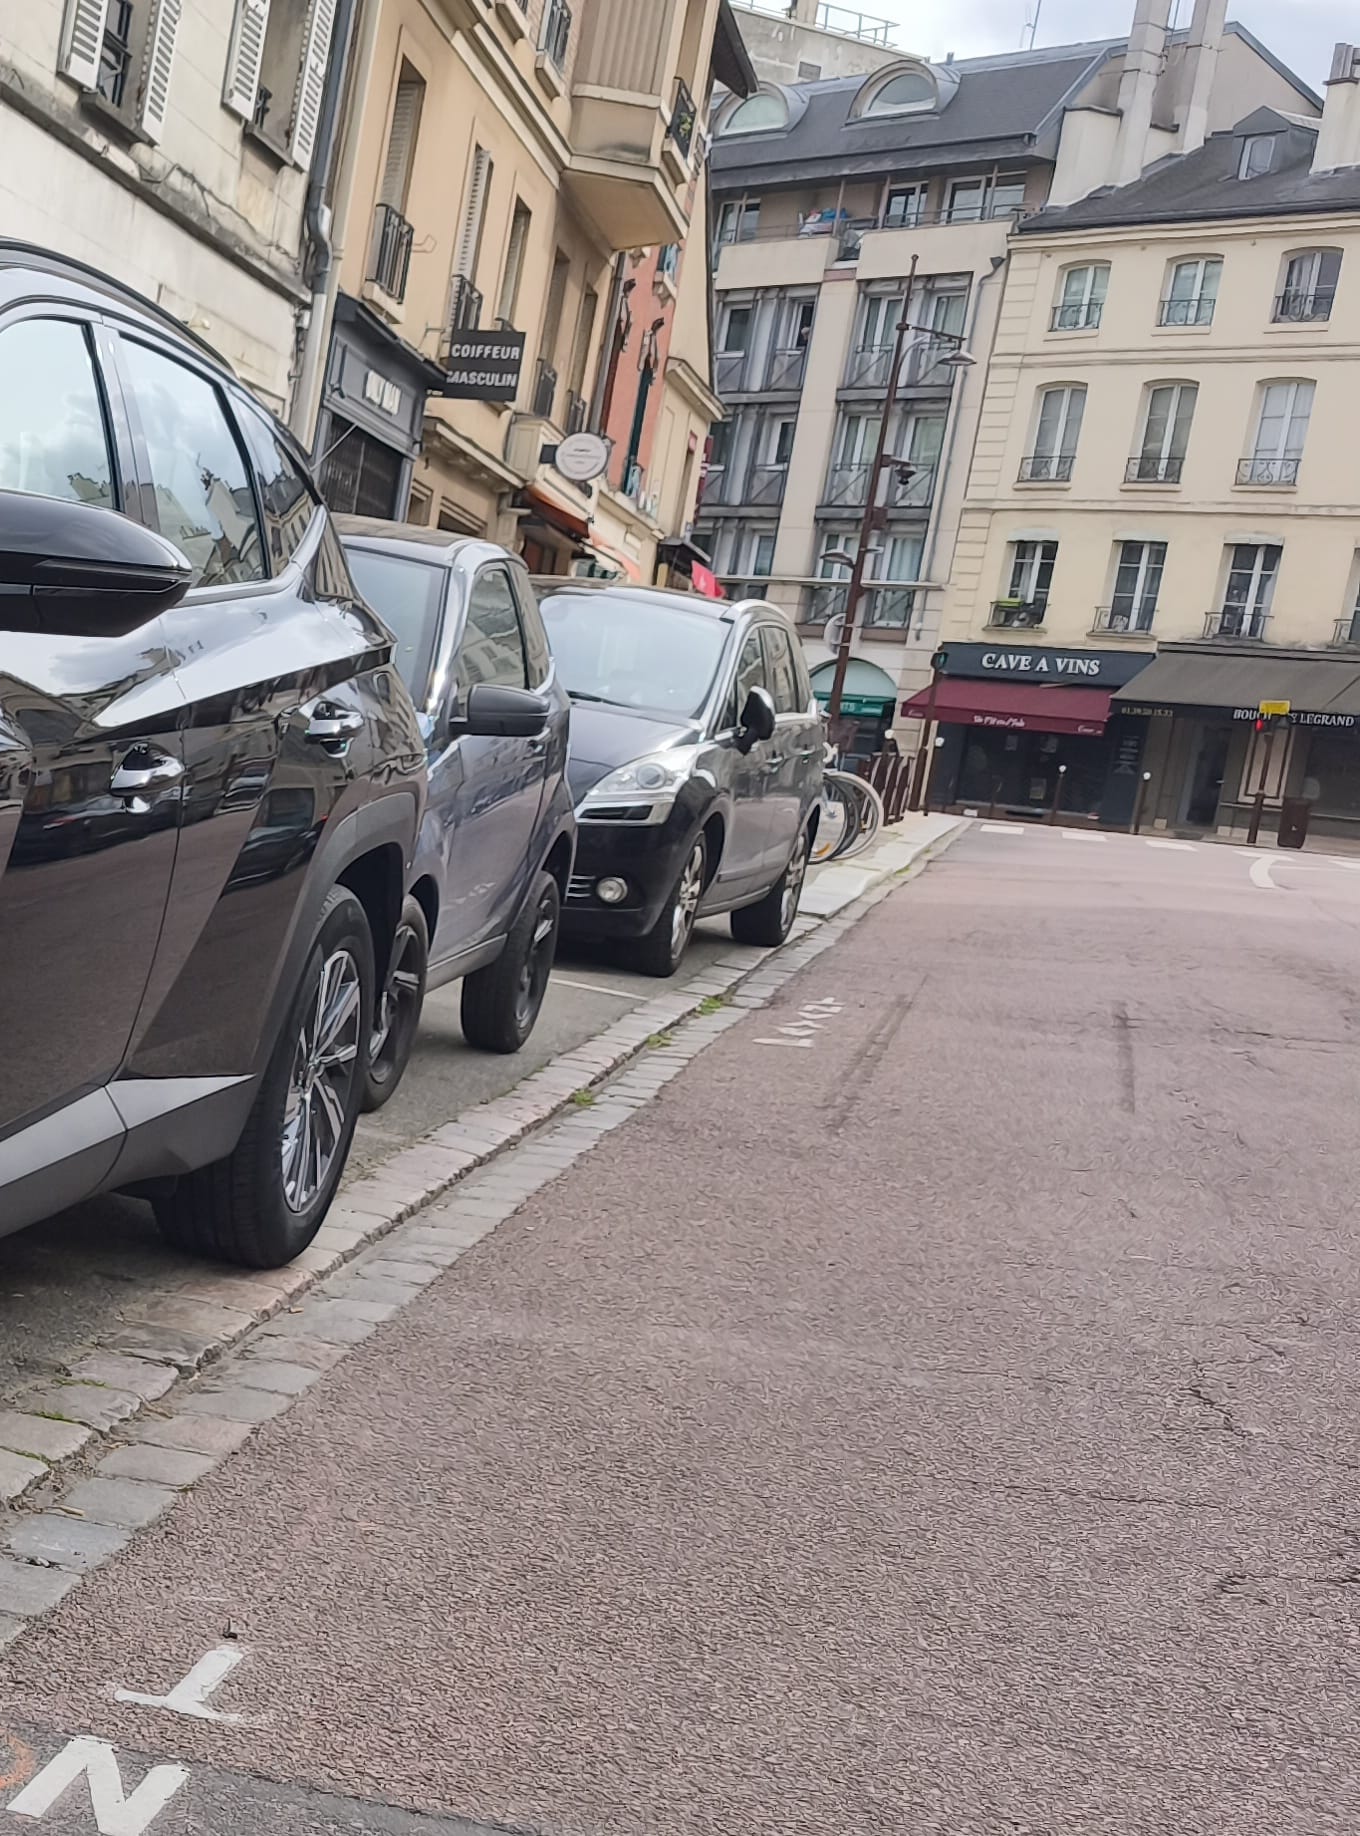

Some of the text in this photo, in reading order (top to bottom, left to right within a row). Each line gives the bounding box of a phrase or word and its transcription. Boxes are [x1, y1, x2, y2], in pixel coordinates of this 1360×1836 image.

[451, 344, 520, 360] COIFFEUR
[981, 653, 1033, 671] CAVE
[1055, 658, 1100, 676] VINS
[1299, 714, 1355, 727] LEGRAND
